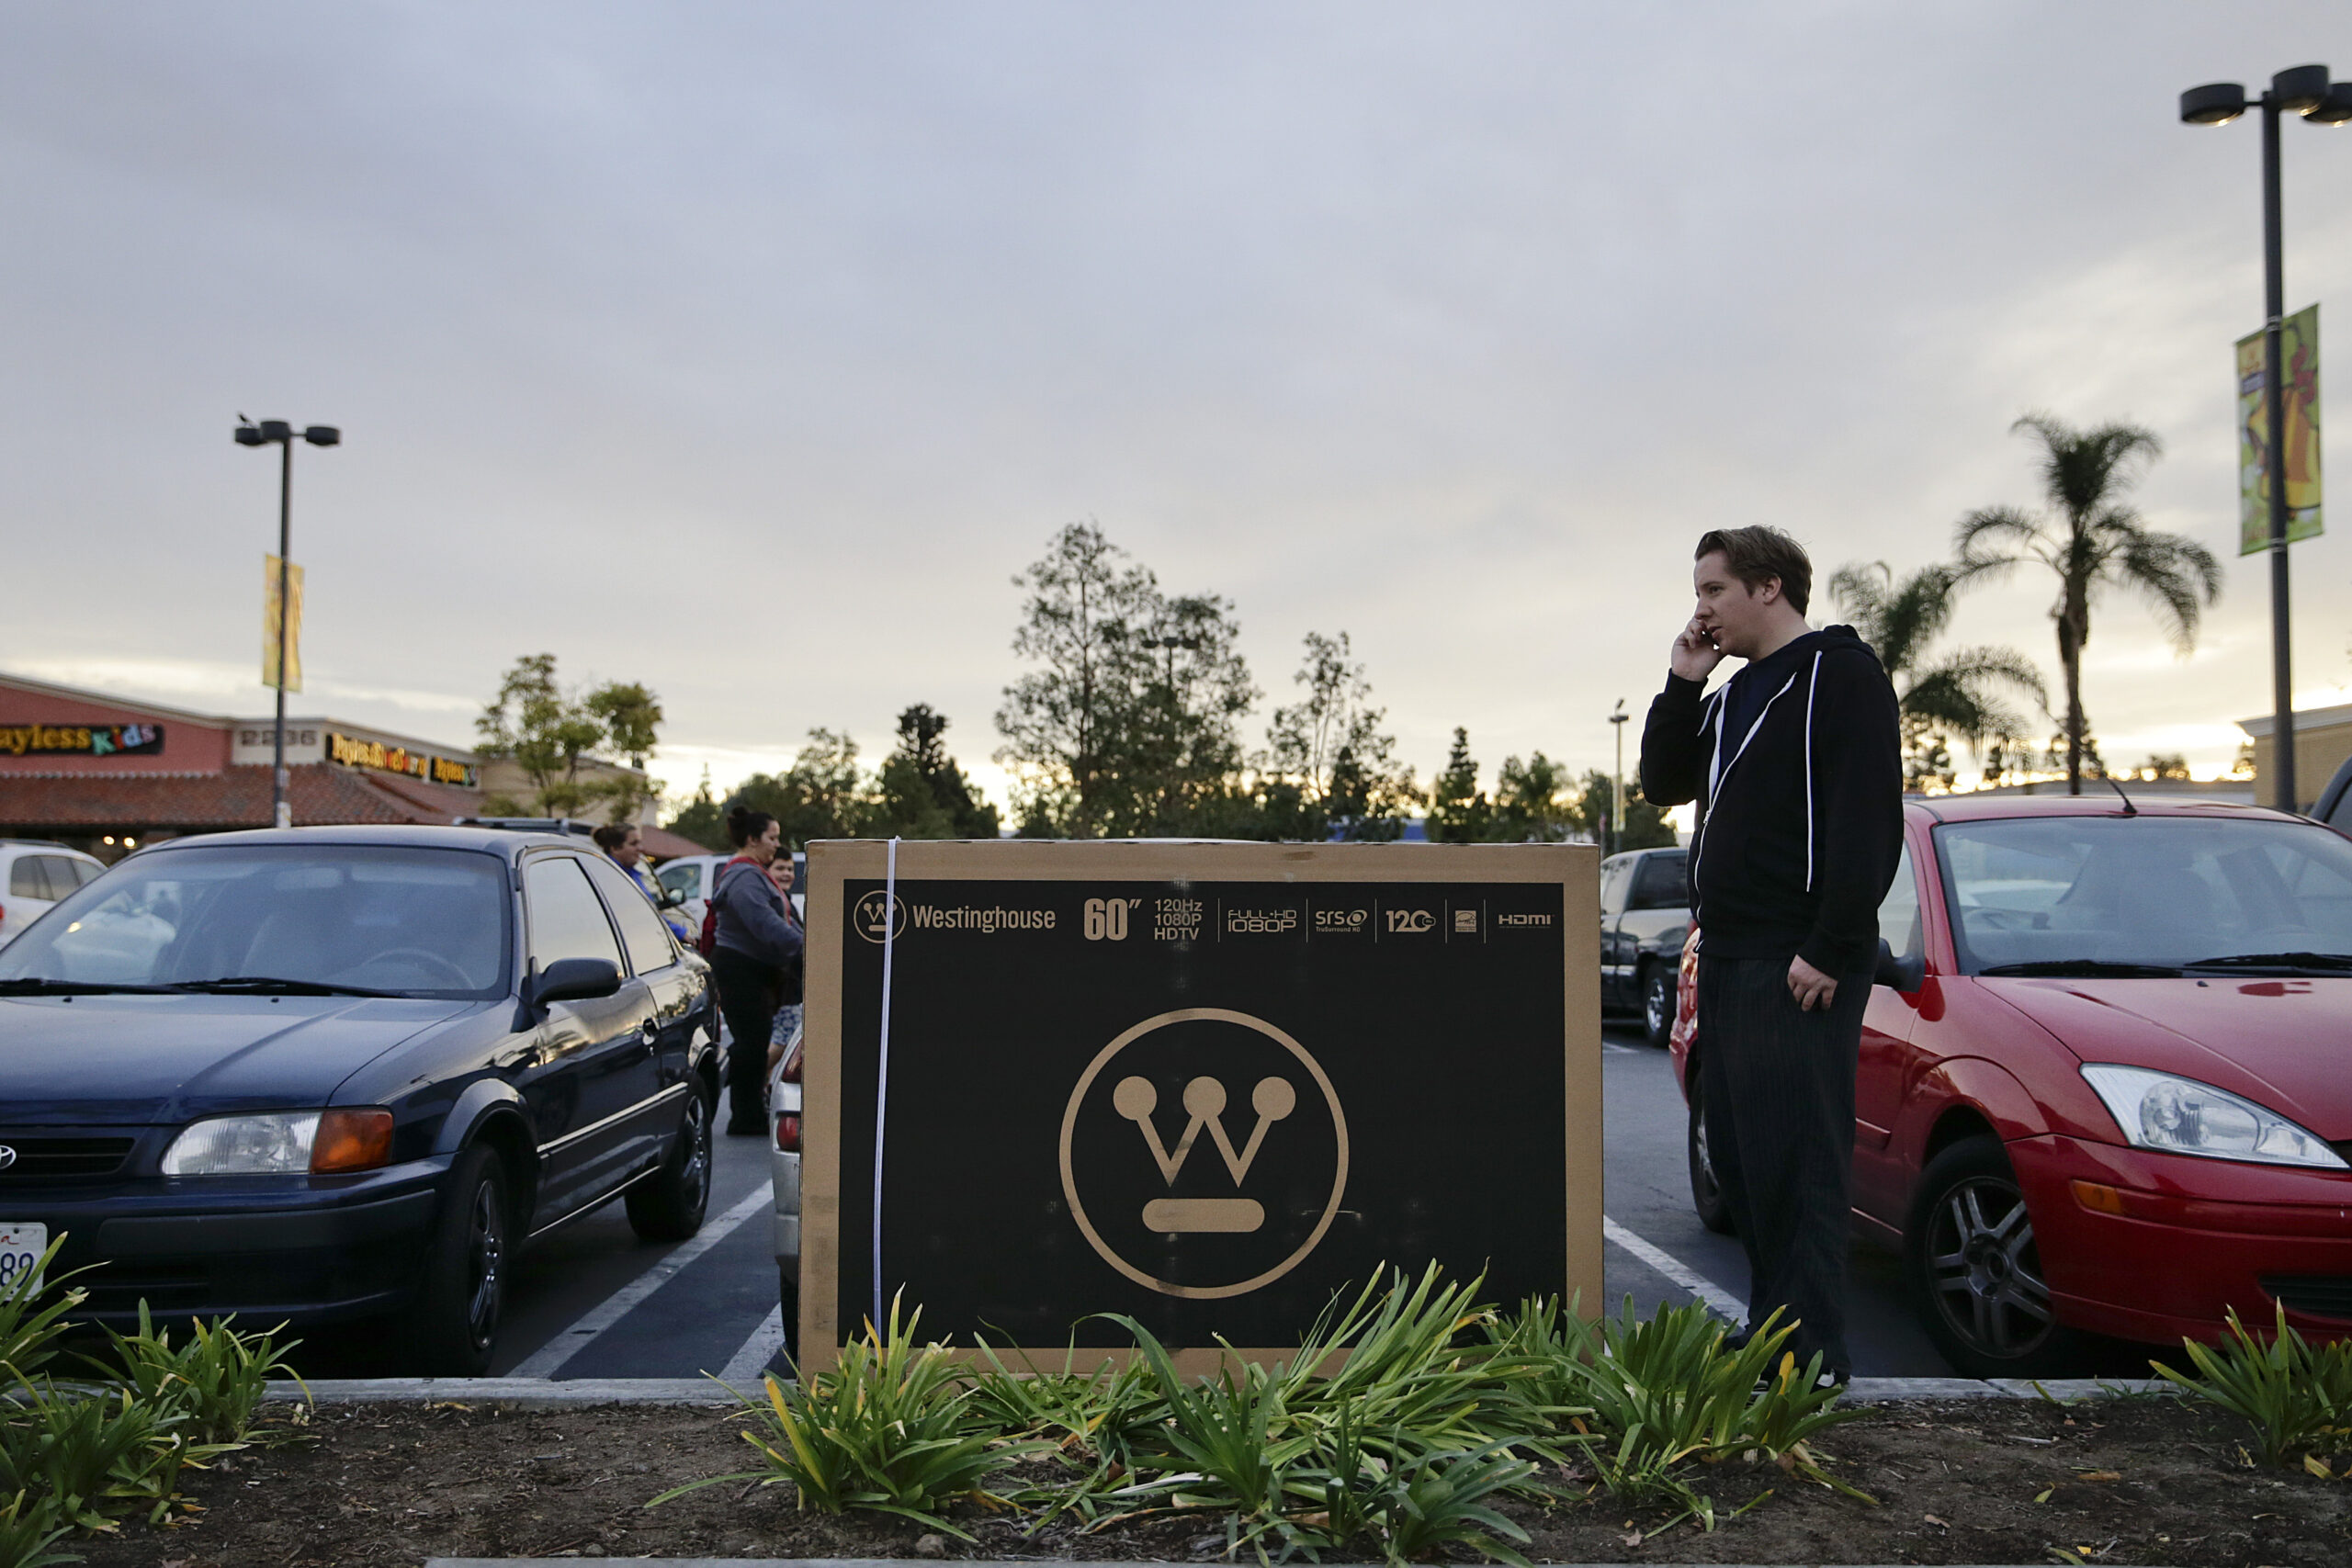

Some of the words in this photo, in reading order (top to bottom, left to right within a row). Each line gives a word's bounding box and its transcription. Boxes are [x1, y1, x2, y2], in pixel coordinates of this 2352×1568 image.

[1155, 898, 1203, 912] 120Hz
[912, 905, 1057, 933] Westinghouse
[1155, 913, 1202, 927] 1080P
[1227, 919, 1297, 932] 1080P
[1498, 914, 1551, 925] HDMI
[1154, 928, 1200, 941] HDTV
